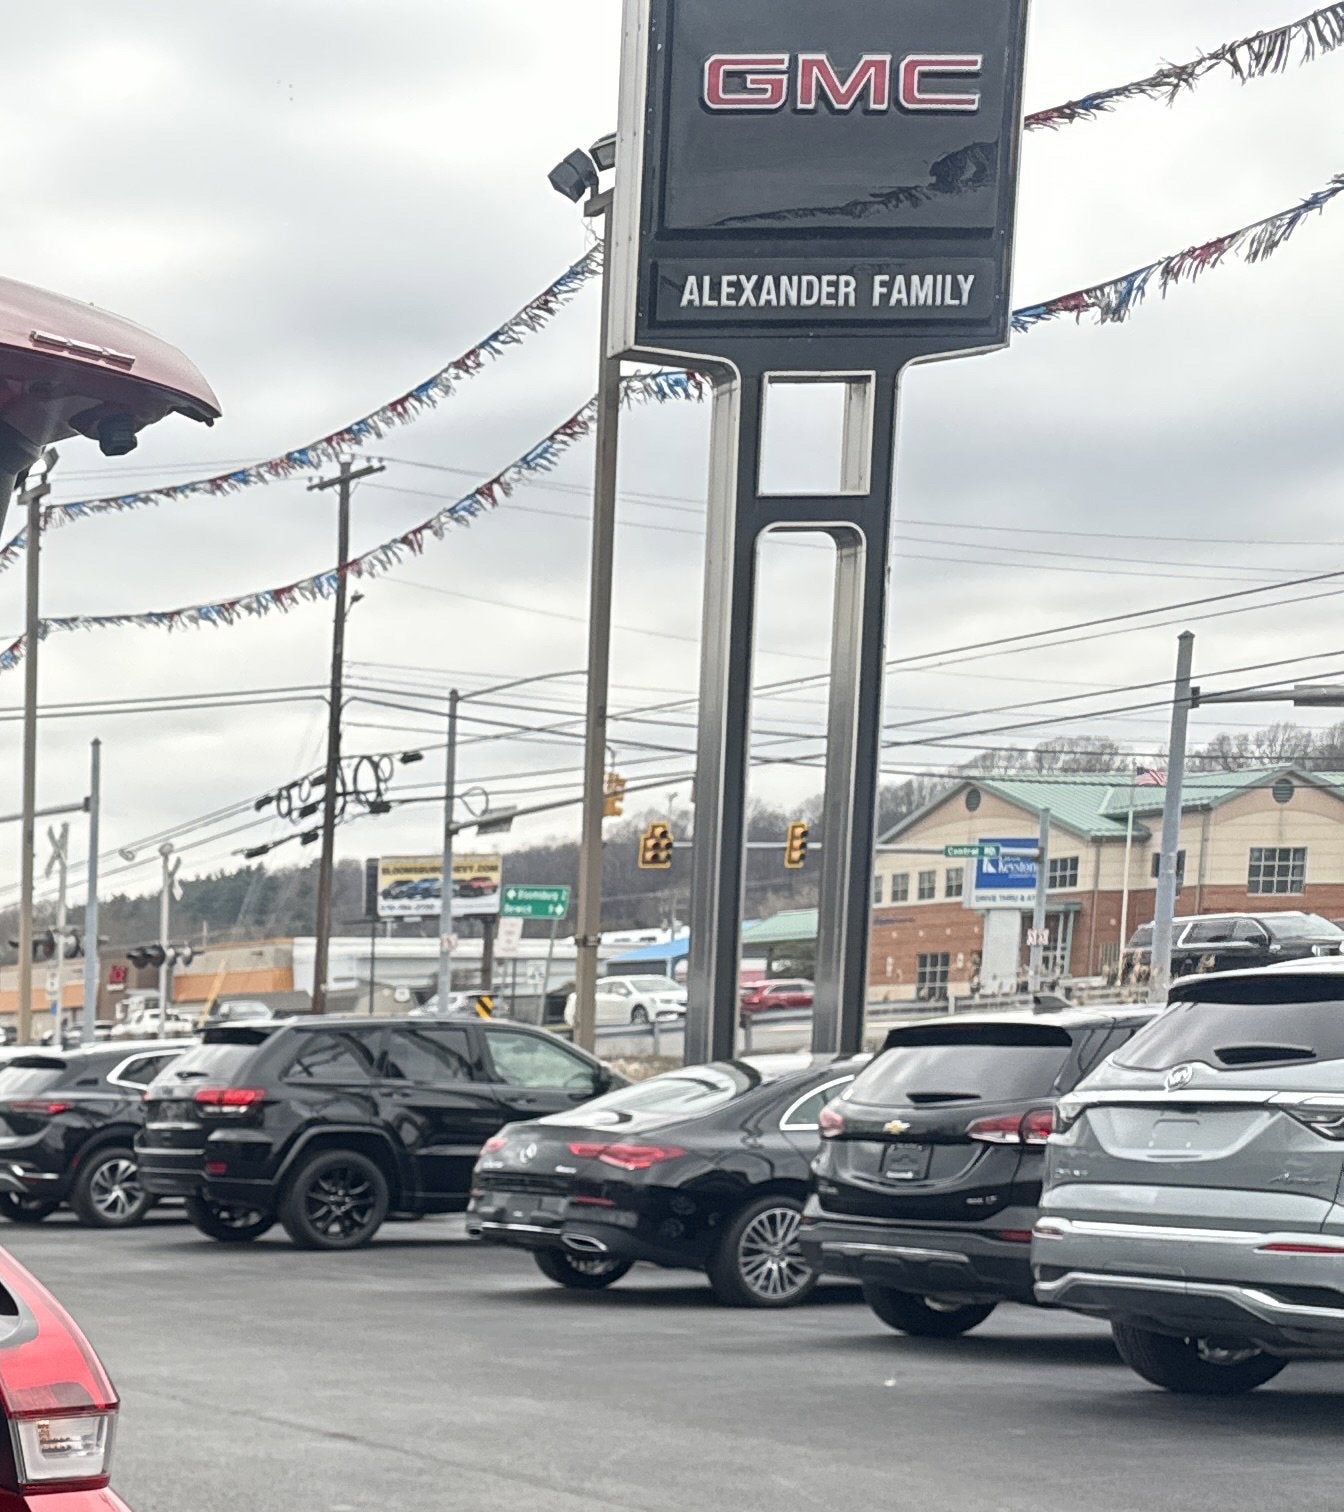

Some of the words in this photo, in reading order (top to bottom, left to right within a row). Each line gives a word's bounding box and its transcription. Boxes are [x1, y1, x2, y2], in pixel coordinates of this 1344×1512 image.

[703, 53, 983, 111] GMC
[680, 274, 856, 308] ALEXANDER
[872, 273, 975, 307] FAMILY
[998, 857, 1037, 874] Keyston
